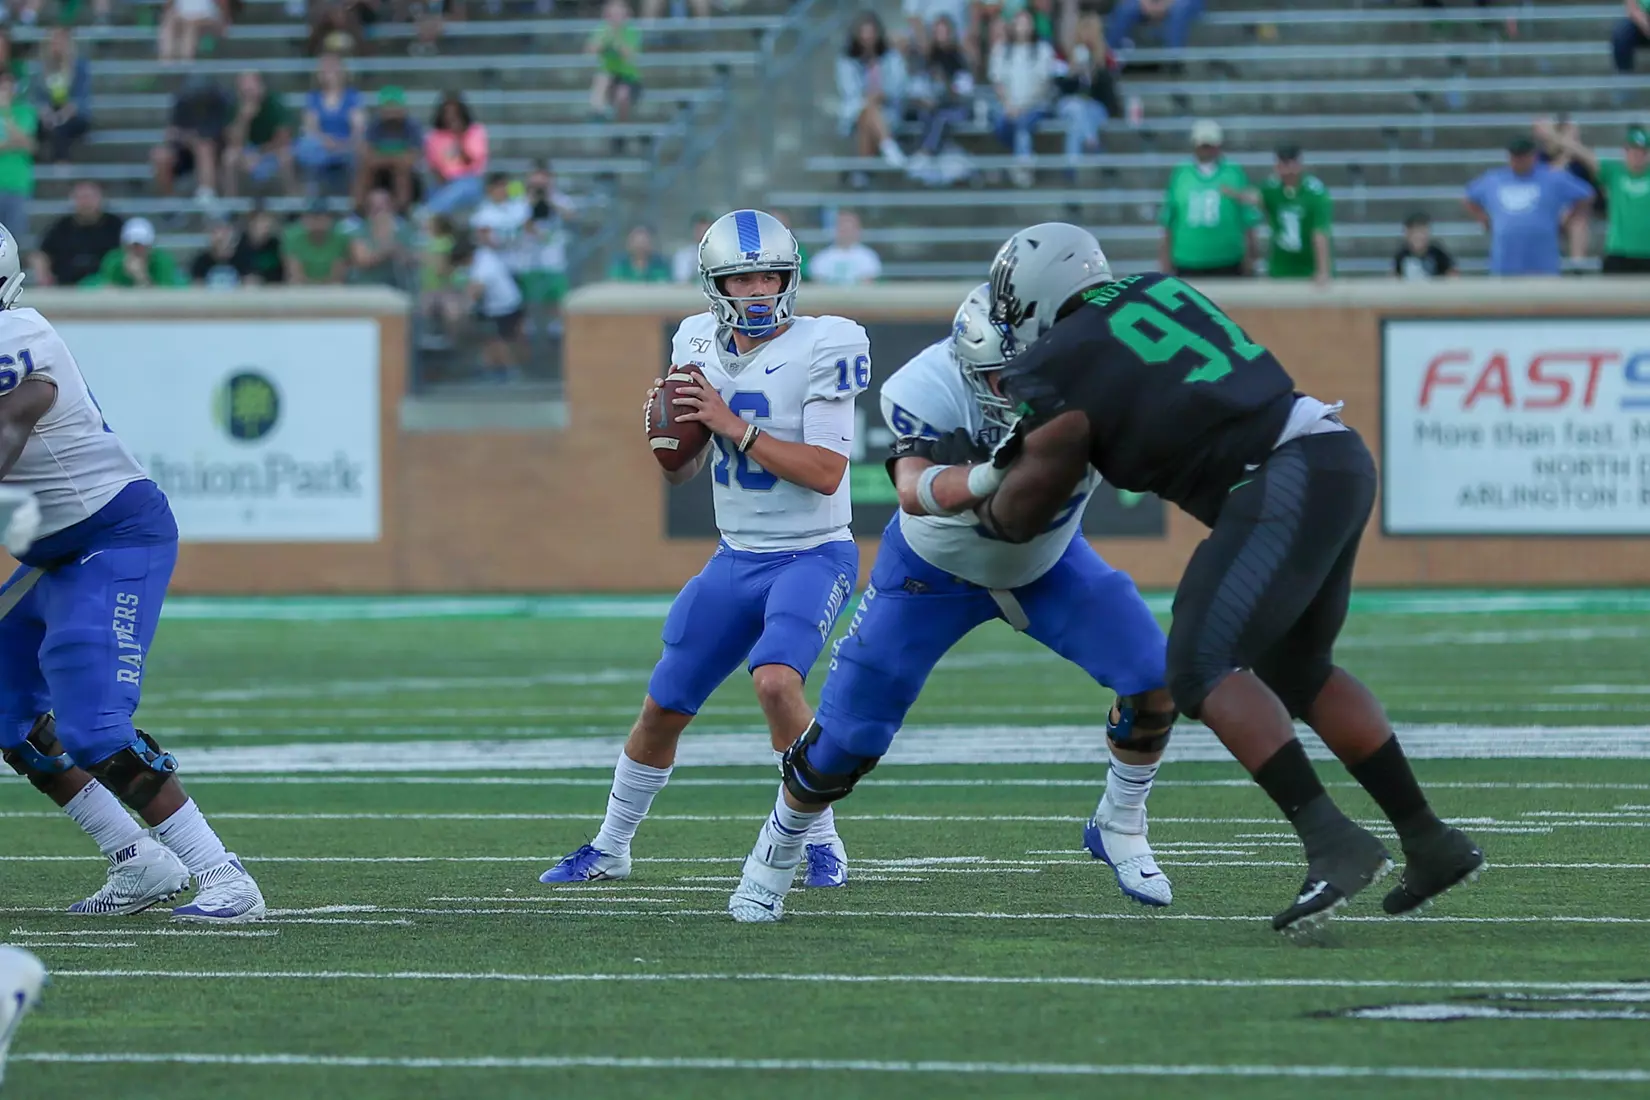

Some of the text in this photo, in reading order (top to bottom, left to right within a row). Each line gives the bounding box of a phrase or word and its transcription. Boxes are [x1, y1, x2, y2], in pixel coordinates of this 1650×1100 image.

[1108, 276, 1266, 383] 97
[834, 354, 869, 391] 16
[1414, 420, 1485, 446] More
[1491, 420, 1556, 446] than
[1532, 456, 1631, 480] NORTH
[1457, 482, 1618, 508] ARLINGTON
[115, 843, 138, 864] NIKE
